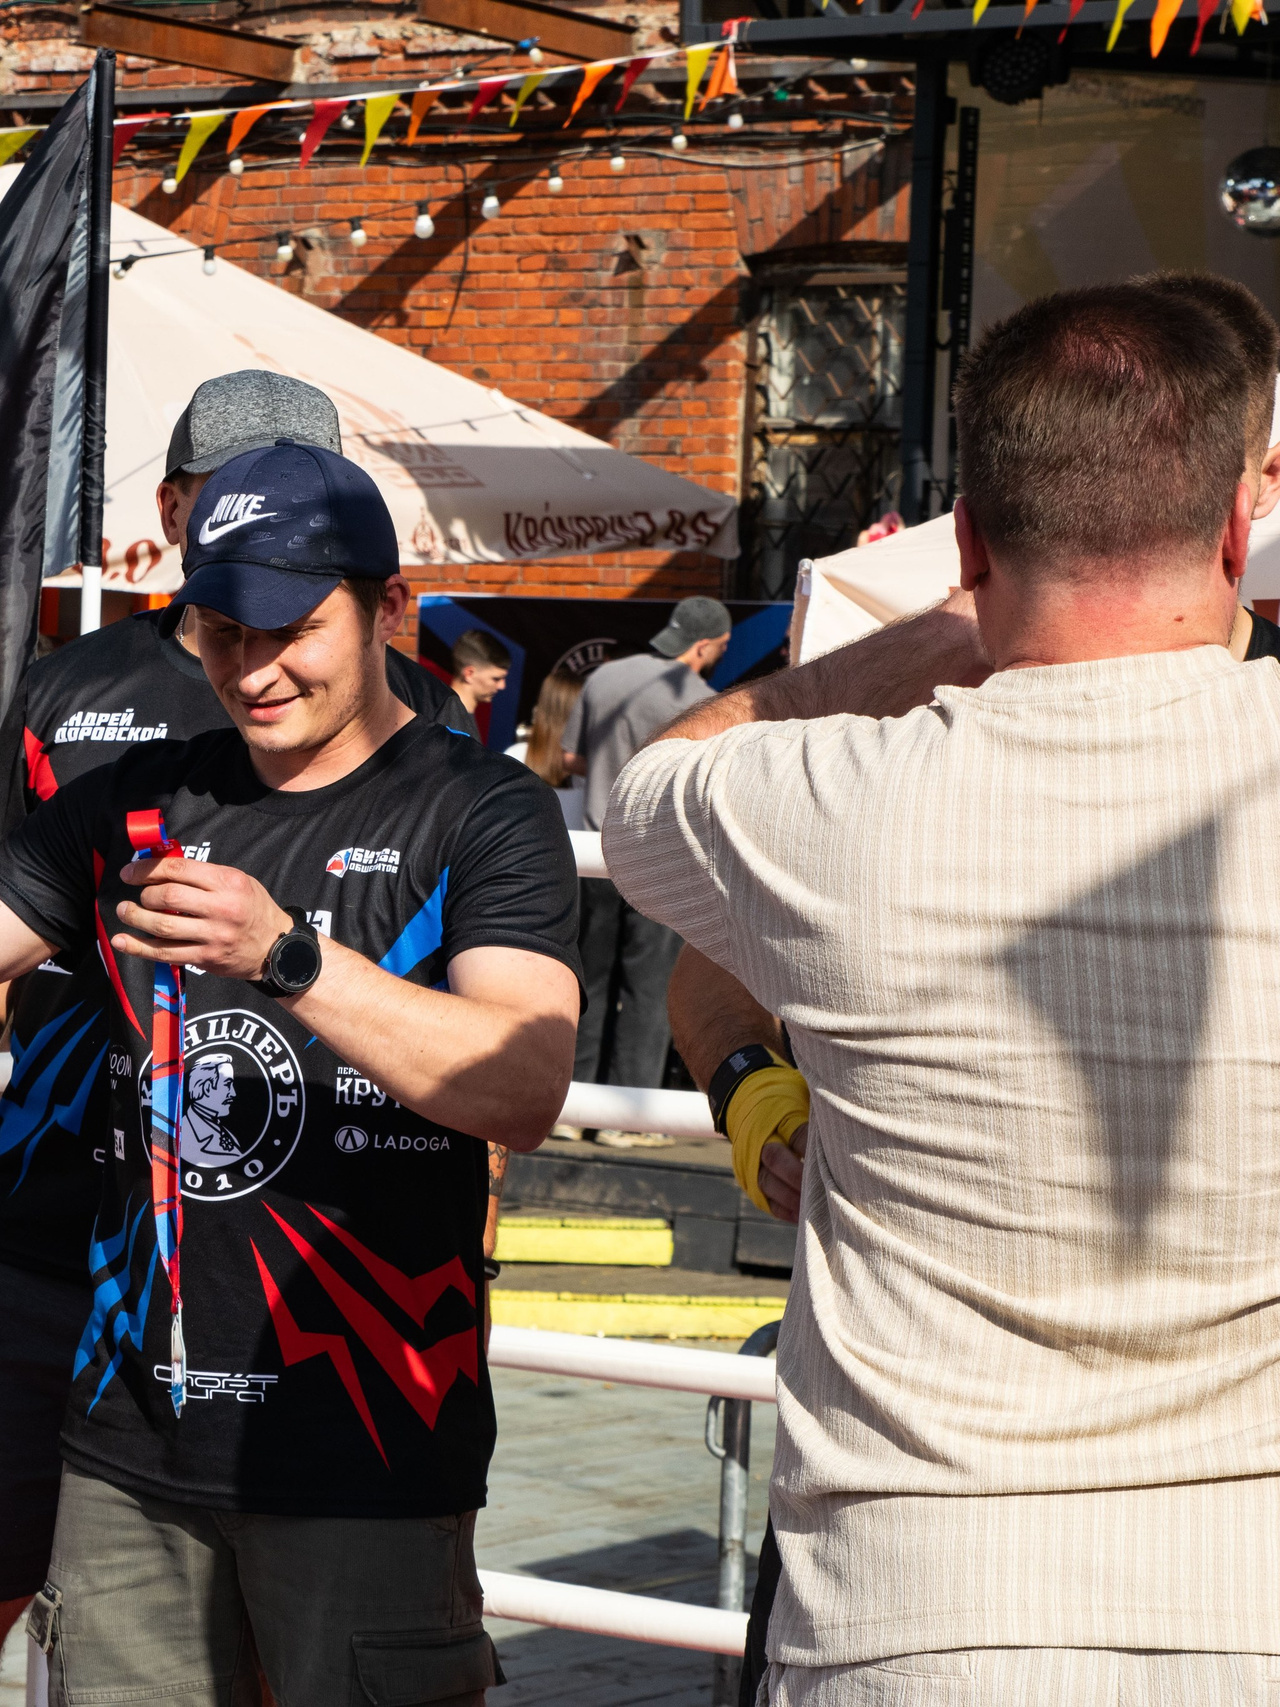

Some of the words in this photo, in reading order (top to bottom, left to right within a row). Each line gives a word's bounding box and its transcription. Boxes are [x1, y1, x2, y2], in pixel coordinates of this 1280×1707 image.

[211, 493, 265, 523] NIKE
[62, 708, 134, 727] НДРЕЙ
[351, 848, 400, 865] БИТВА
[374, 1134, 450, 1151] LADOGA
